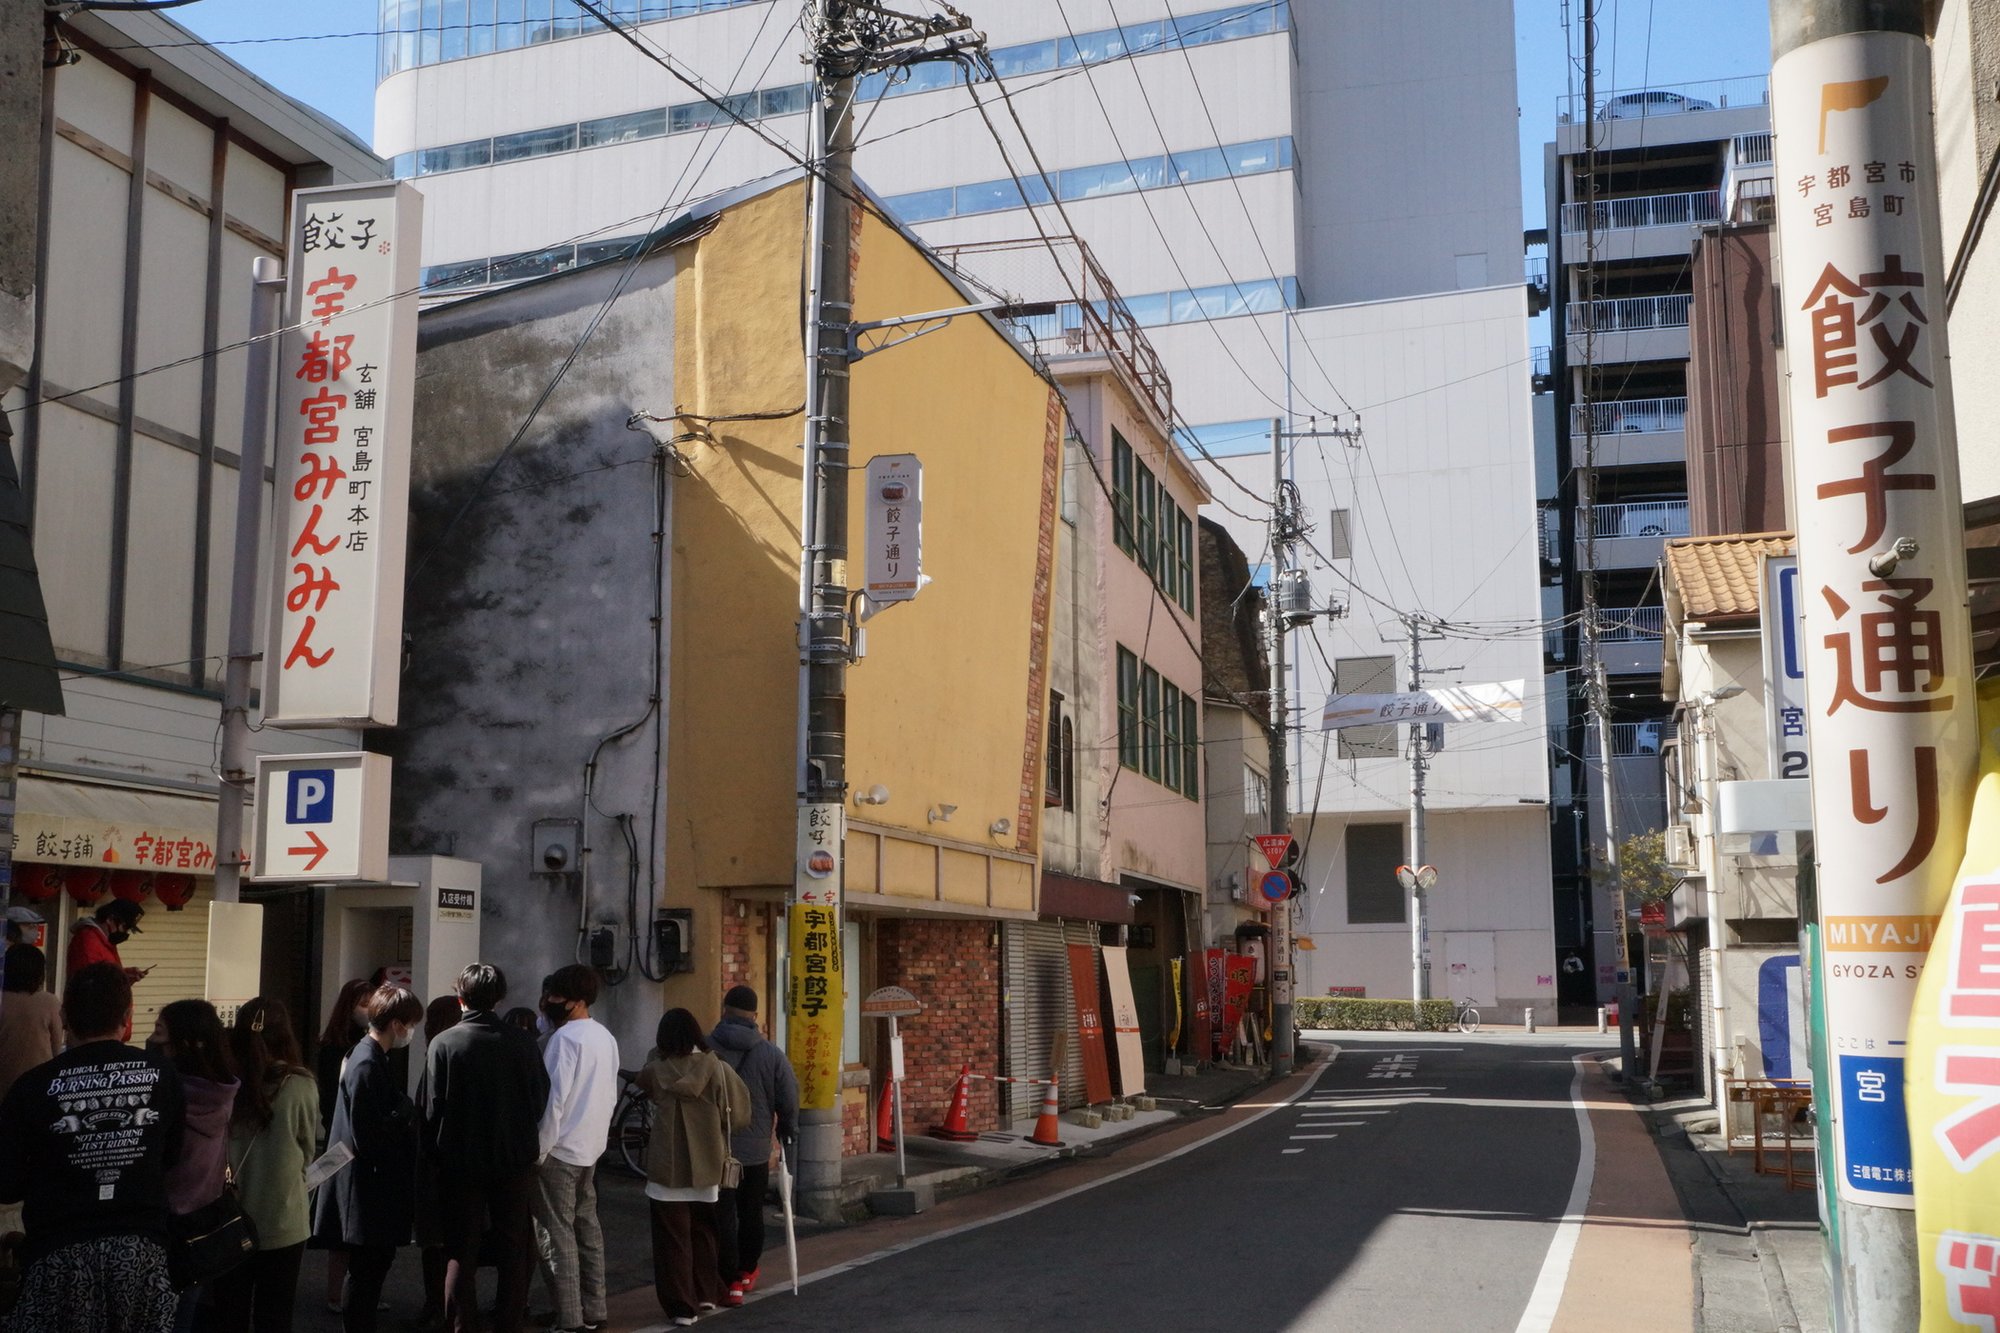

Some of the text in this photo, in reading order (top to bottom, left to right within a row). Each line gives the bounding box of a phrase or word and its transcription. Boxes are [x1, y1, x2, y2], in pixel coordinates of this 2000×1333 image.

[1797, 160, 1916, 199] 宇都宮市
[1813, 193, 1904, 228] 宮島町
[302, 213, 377, 253] 餃子
[284, 266, 357, 670] 宇都宮みんみん
[346, 426, 374, 552] 宮島町本店
[886, 507, 901, 579] 餃子通り
[1800, 254, 1954, 885] 餃子通り
[1380, 702, 1444, 718] 餃子通り
[297, 777, 326, 819] P
[36, 830, 94, 859] 餃子舗
[1266, 847, 1283, 855] STOP
[802, 910, 828, 1018] 宇都宮餃子
[1833, 964, 1895, 979] GYOZA
[1838, 1036, 1875, 1050] ここは
[59, 1061, 148, 1077] RADICAL IDENTITY
[803, 1023, 819, 1105] 宇都宮みんみん
[74, 1129, 144, 1143] NOT STANDING
[78, 1138, 140, 1152] JUST RIDING
